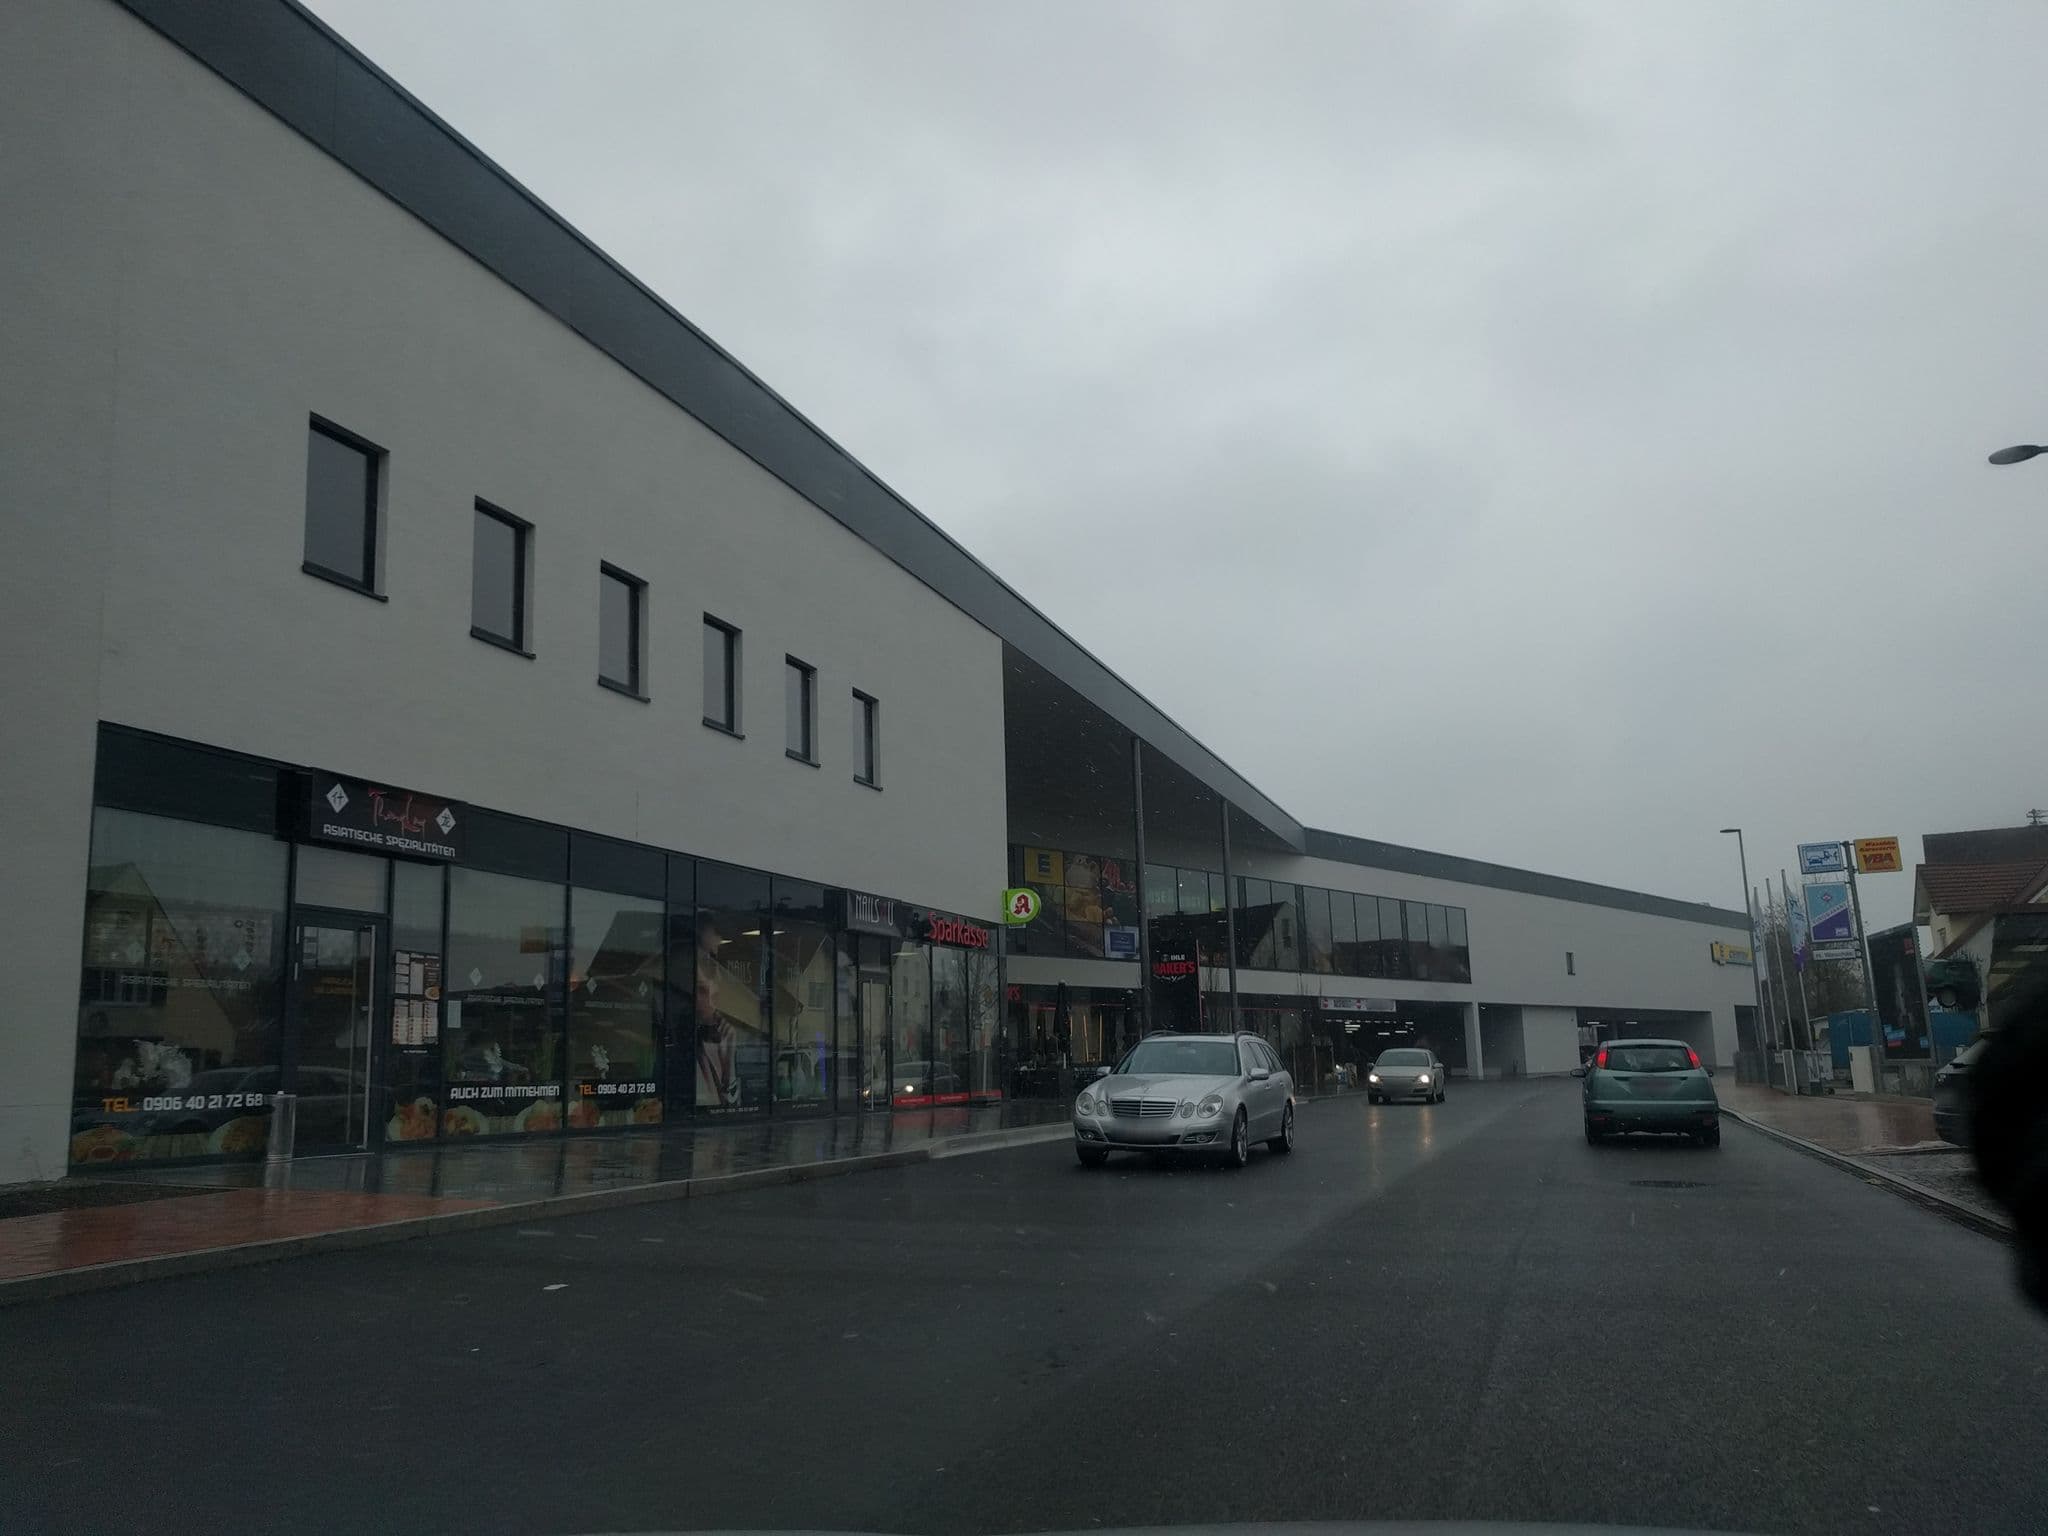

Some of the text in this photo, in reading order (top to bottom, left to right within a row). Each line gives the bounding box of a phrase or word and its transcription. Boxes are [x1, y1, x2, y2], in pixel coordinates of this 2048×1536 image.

[323, 823, 456, 858] ASIATISCHE SPEZIALITÄTEN
[855, 893, 880, 923] NAILS
[927, 911, 990, 948] Sparkasse
[450, 1084, 560, 1099] AUCH ZUM MITNEHMEN
[597, 1084, 617, 1094] 0906
[618, 1083, 627, 1094] 40
[628, 1083, 636, 1094] 21
[637, 1083, 645, 1093] 72
[646, 1082, 656, 1093] 68
[143, 1096, 182, 1111] 0906
[185, 1095, 205, 1110] 40
[208, 1094, 223, 1109] 21
[225, 1093, 243, 1108] 72
[245, 1093, 263, 1107] 68
